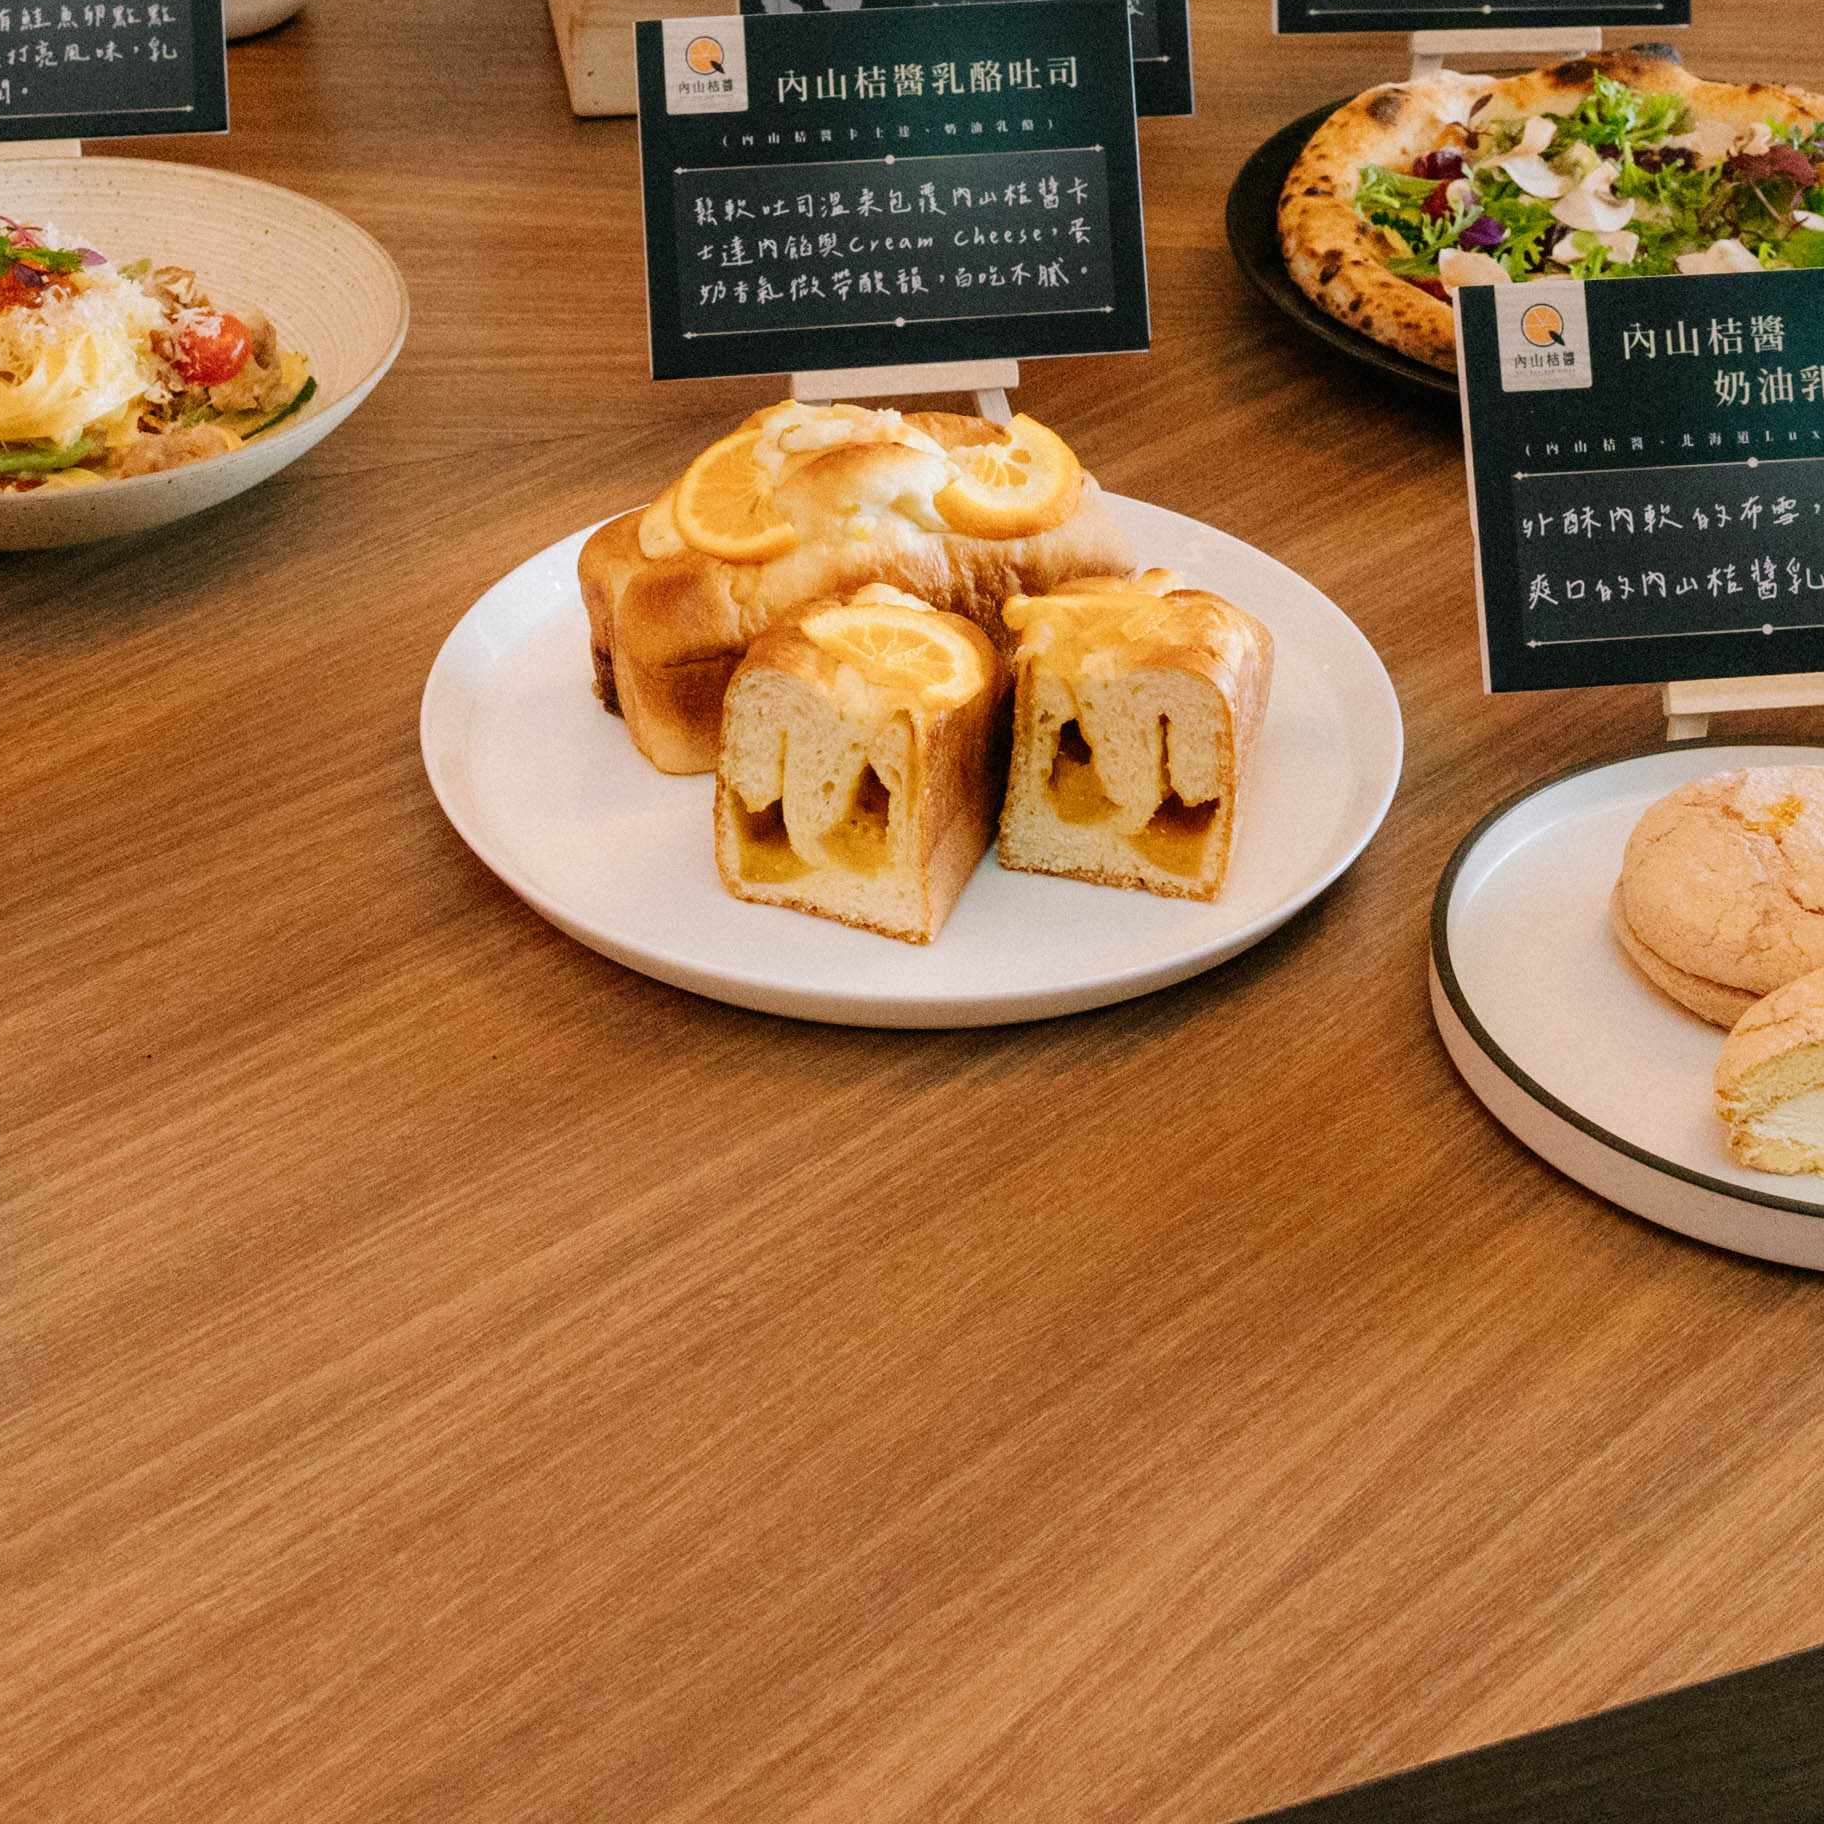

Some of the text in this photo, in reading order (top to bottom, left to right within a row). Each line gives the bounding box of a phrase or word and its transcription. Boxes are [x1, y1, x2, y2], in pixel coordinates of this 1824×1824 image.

[778, 56, 1078, 103] 內山桔醬乳酪吐司
[1622, 315, 1785, 360] 內山桔醬
